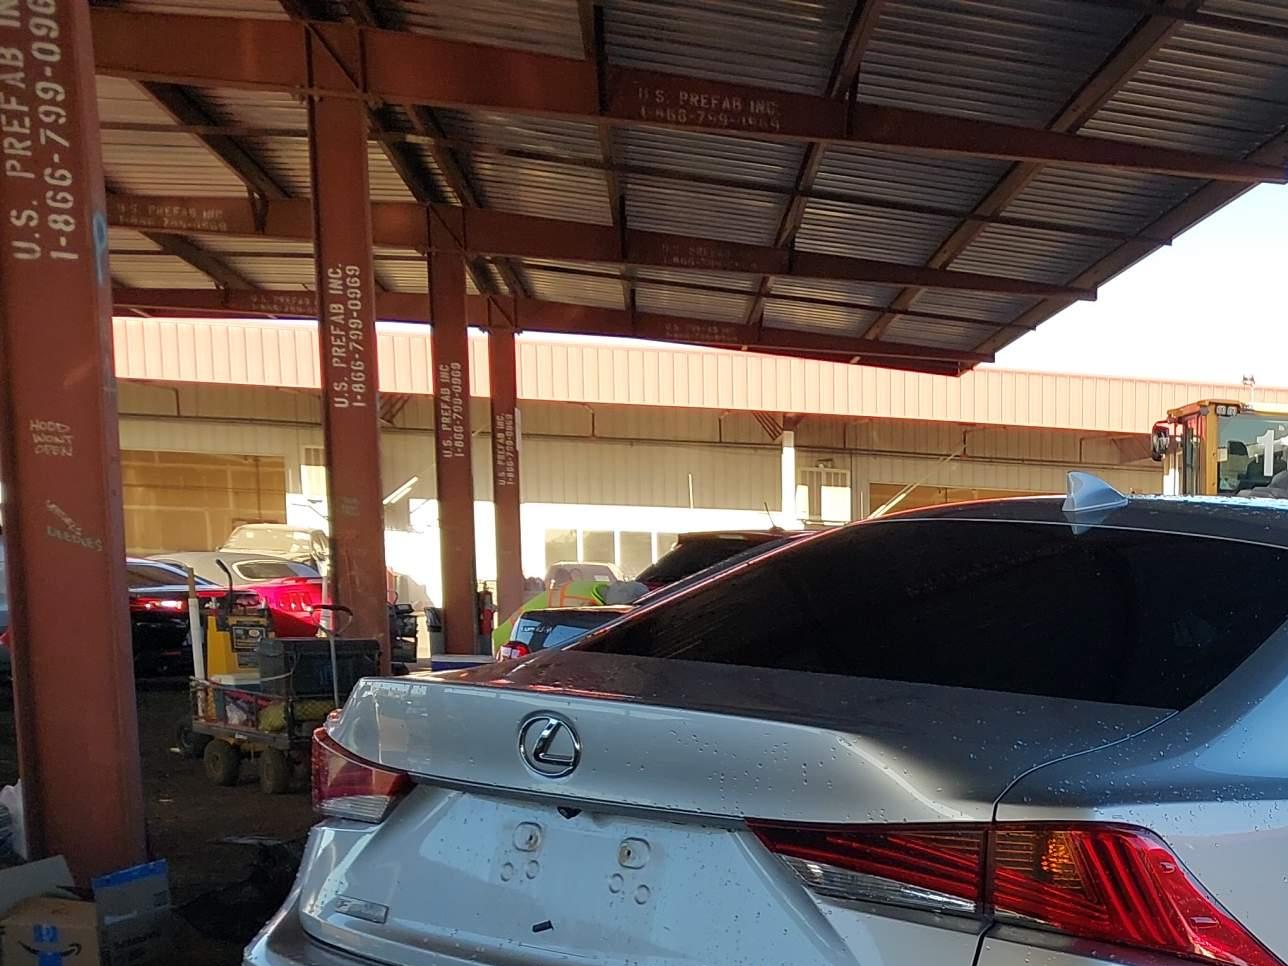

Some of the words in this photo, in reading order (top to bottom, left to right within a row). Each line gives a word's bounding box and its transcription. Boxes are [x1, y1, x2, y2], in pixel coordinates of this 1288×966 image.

[0, 46, 36, 179] PREFAB
[10, 201, 42, 260] U.S.
[327, 263, 343, 295] INC.
[329, 303, 347, 368] PREFAB
[346, 265, 366, 407] 1-866-799-0969
[333, 377, 349, 408] U.S.
